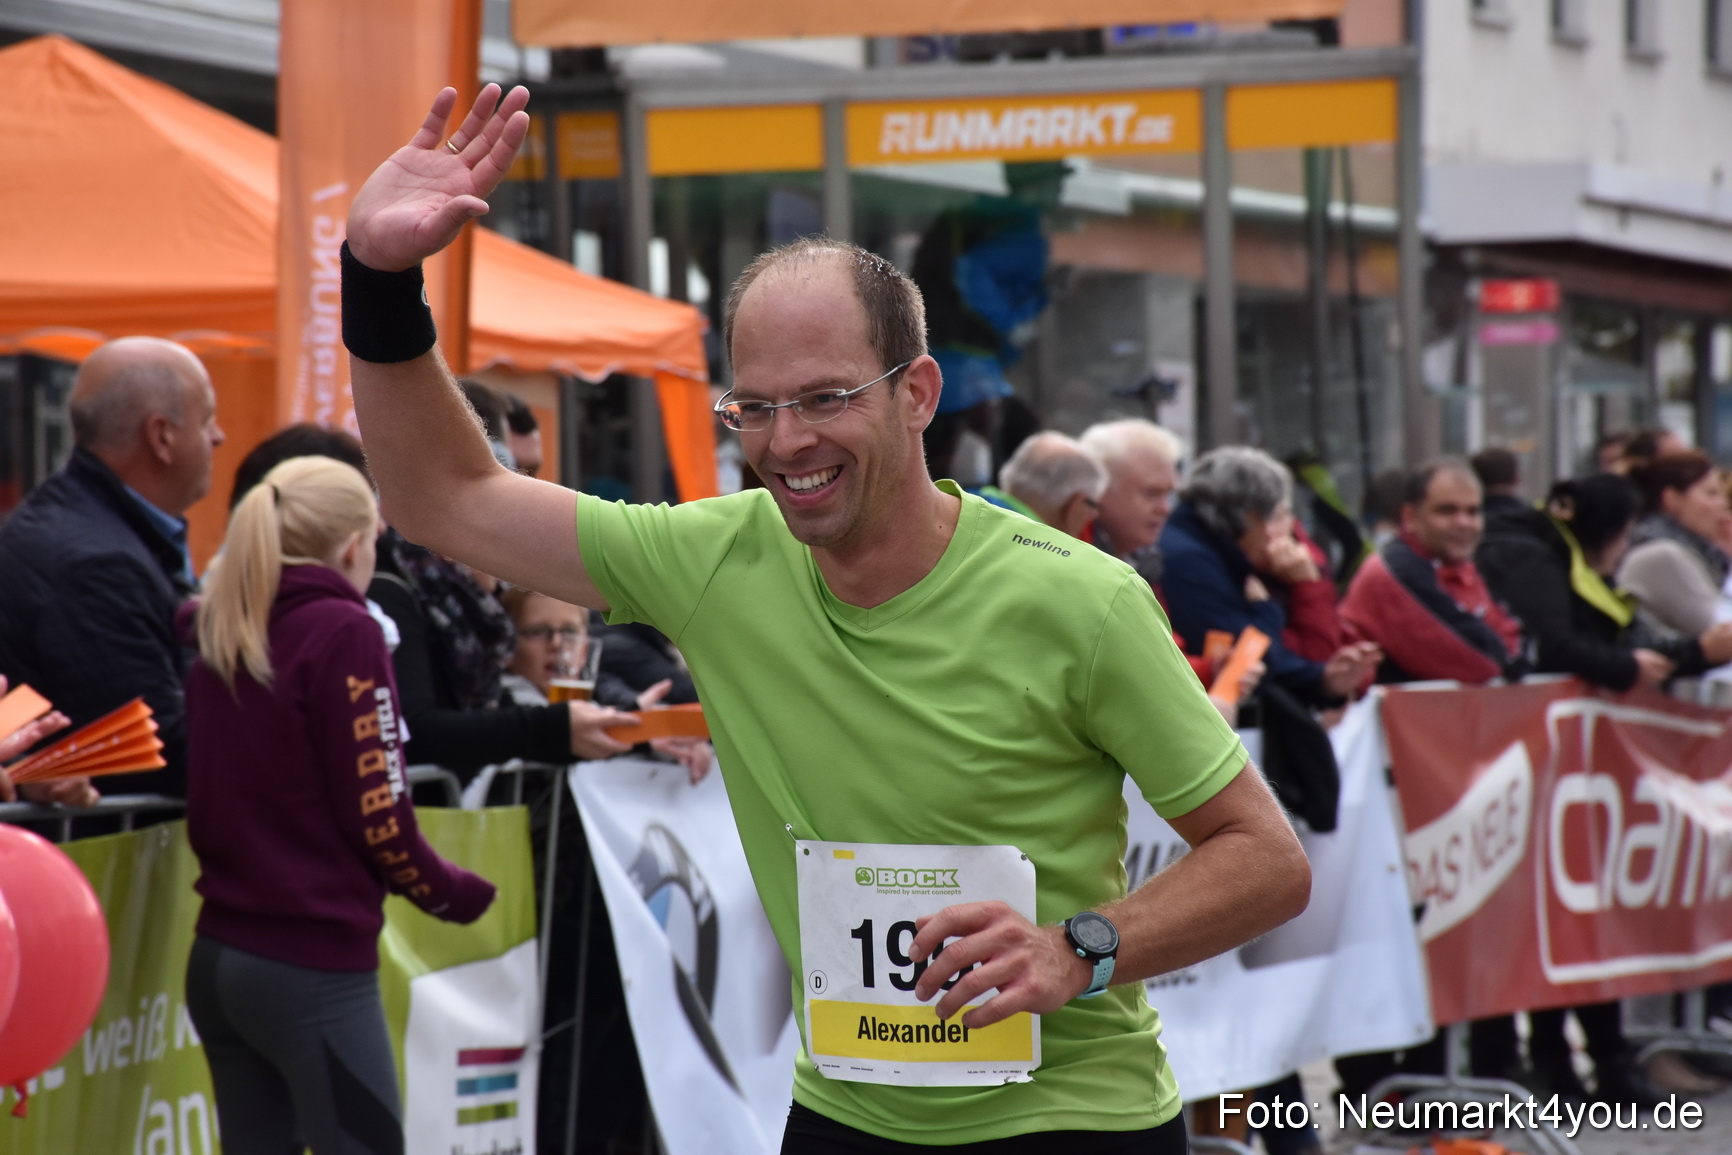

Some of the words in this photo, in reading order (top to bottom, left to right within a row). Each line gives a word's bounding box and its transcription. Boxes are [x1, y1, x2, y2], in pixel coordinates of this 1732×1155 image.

[1011, 533, 1071, 557] newline
[876, 868, 960, 888] BOCK
[902, 888, 910, 896] by
[814, 976, 823, 989] D
[857, 1015, 969, 1043] Alexander
